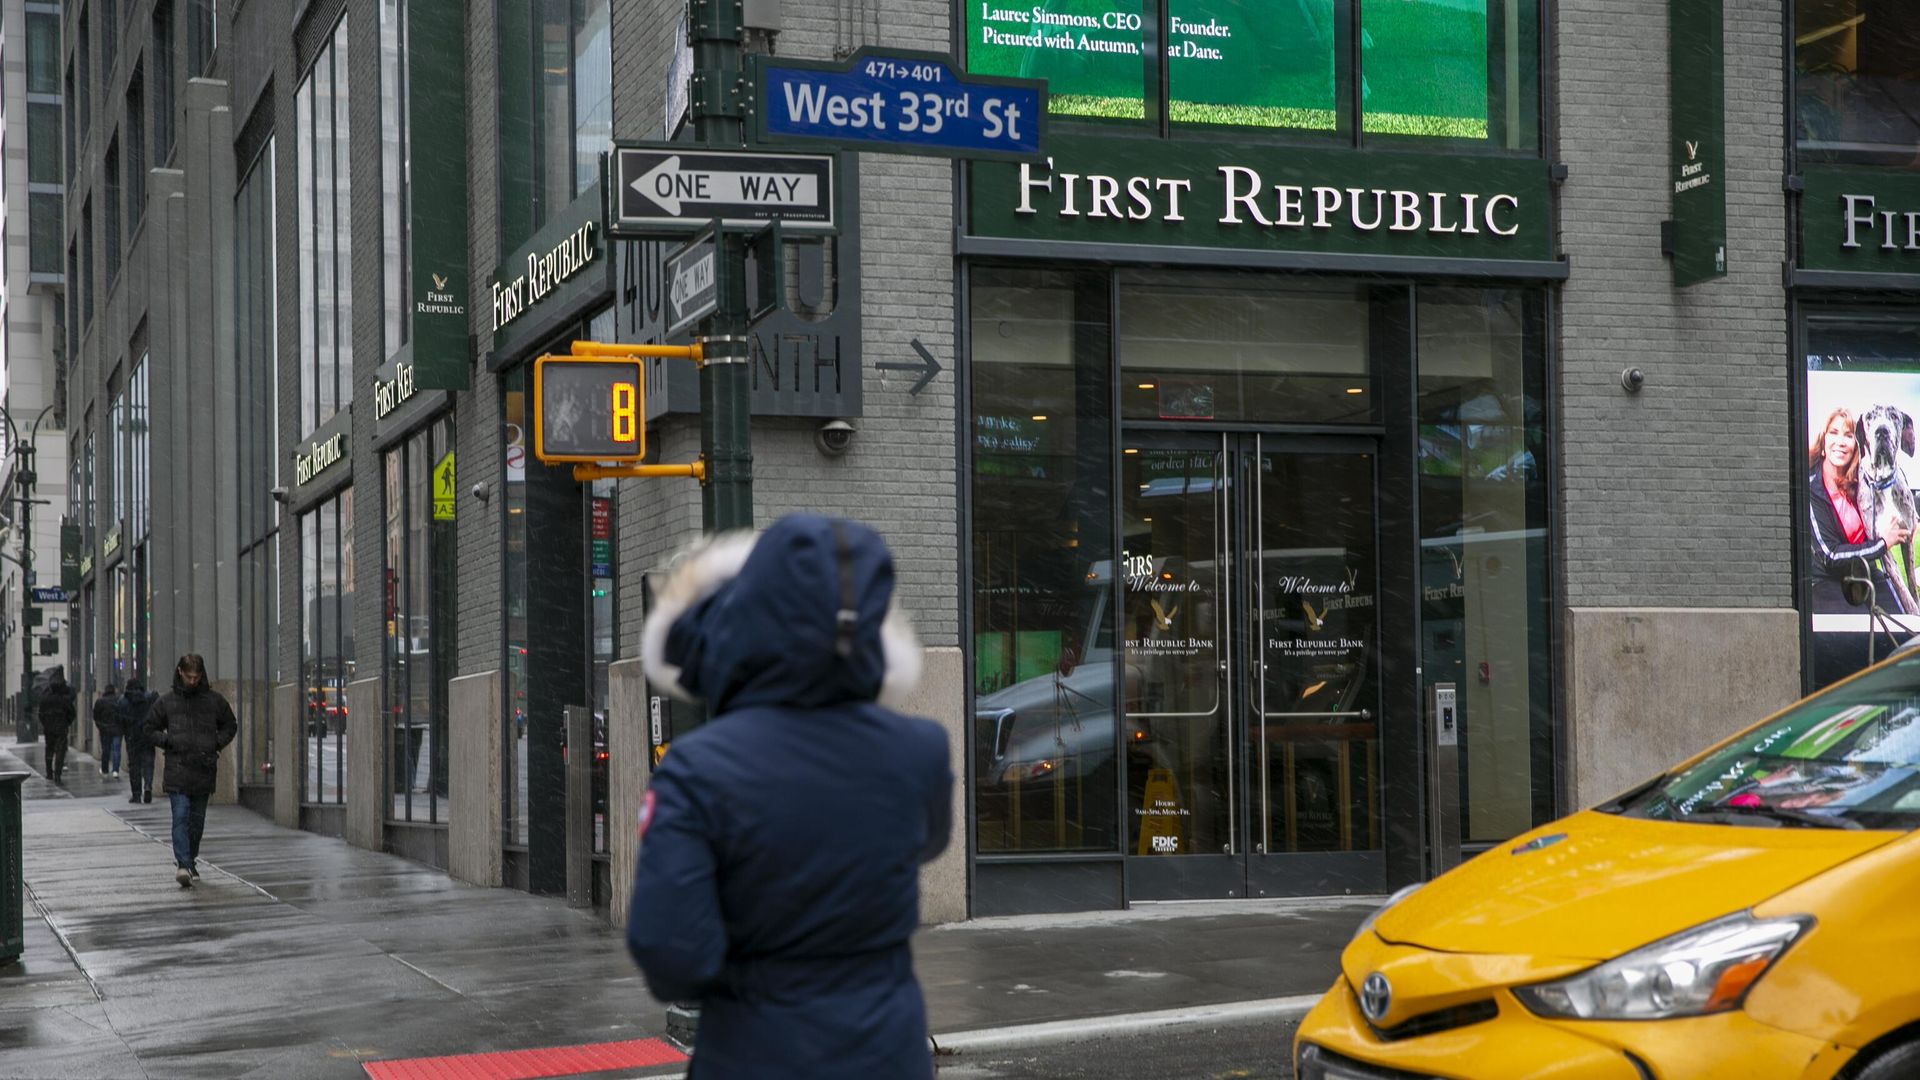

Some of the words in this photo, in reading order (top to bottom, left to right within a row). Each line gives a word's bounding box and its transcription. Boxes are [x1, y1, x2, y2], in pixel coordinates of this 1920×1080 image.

[982, 3, 1030, 24] Lauree
[1032, 6, 1101, 30] Simmons,
[1103, 13, 1141, 31] CEO
[1171, 16, 1231, 38] Founder.
[983, 26, 1042, 48] Pictured
[1042, 30, 1075, 51] with
[1077, 36, 1140, 56] Autumn,
[1184, 40, 1223, 60] Dane.
[783, 82, 886, 130] West
[898, 91, 969, 134] 33rd
[982, 99, 1021, 140] St
[655, 172, 711, 200] ONE
[740, 175, 801, 202] WAY
[1217, 165, 1519, 236] REPUBLIC
[674, 273, 688, 306] ONE
[694, 259, 710, 291] WAY
[612, 382, 635, 443] 8
[1127, 576, 1186, 592] Welcome
[1189, 580, 1200, 592] to
[1279, 576, 1337, 594] Welcome
[1338, 581, 1350, 593] to
[1125, 639, 1140, 647] RST
[1189, 638, 1213, 647] BANK
[1340, 638, 1364, 648] BANK
[1152, 836, 1178, 848] FDIC
